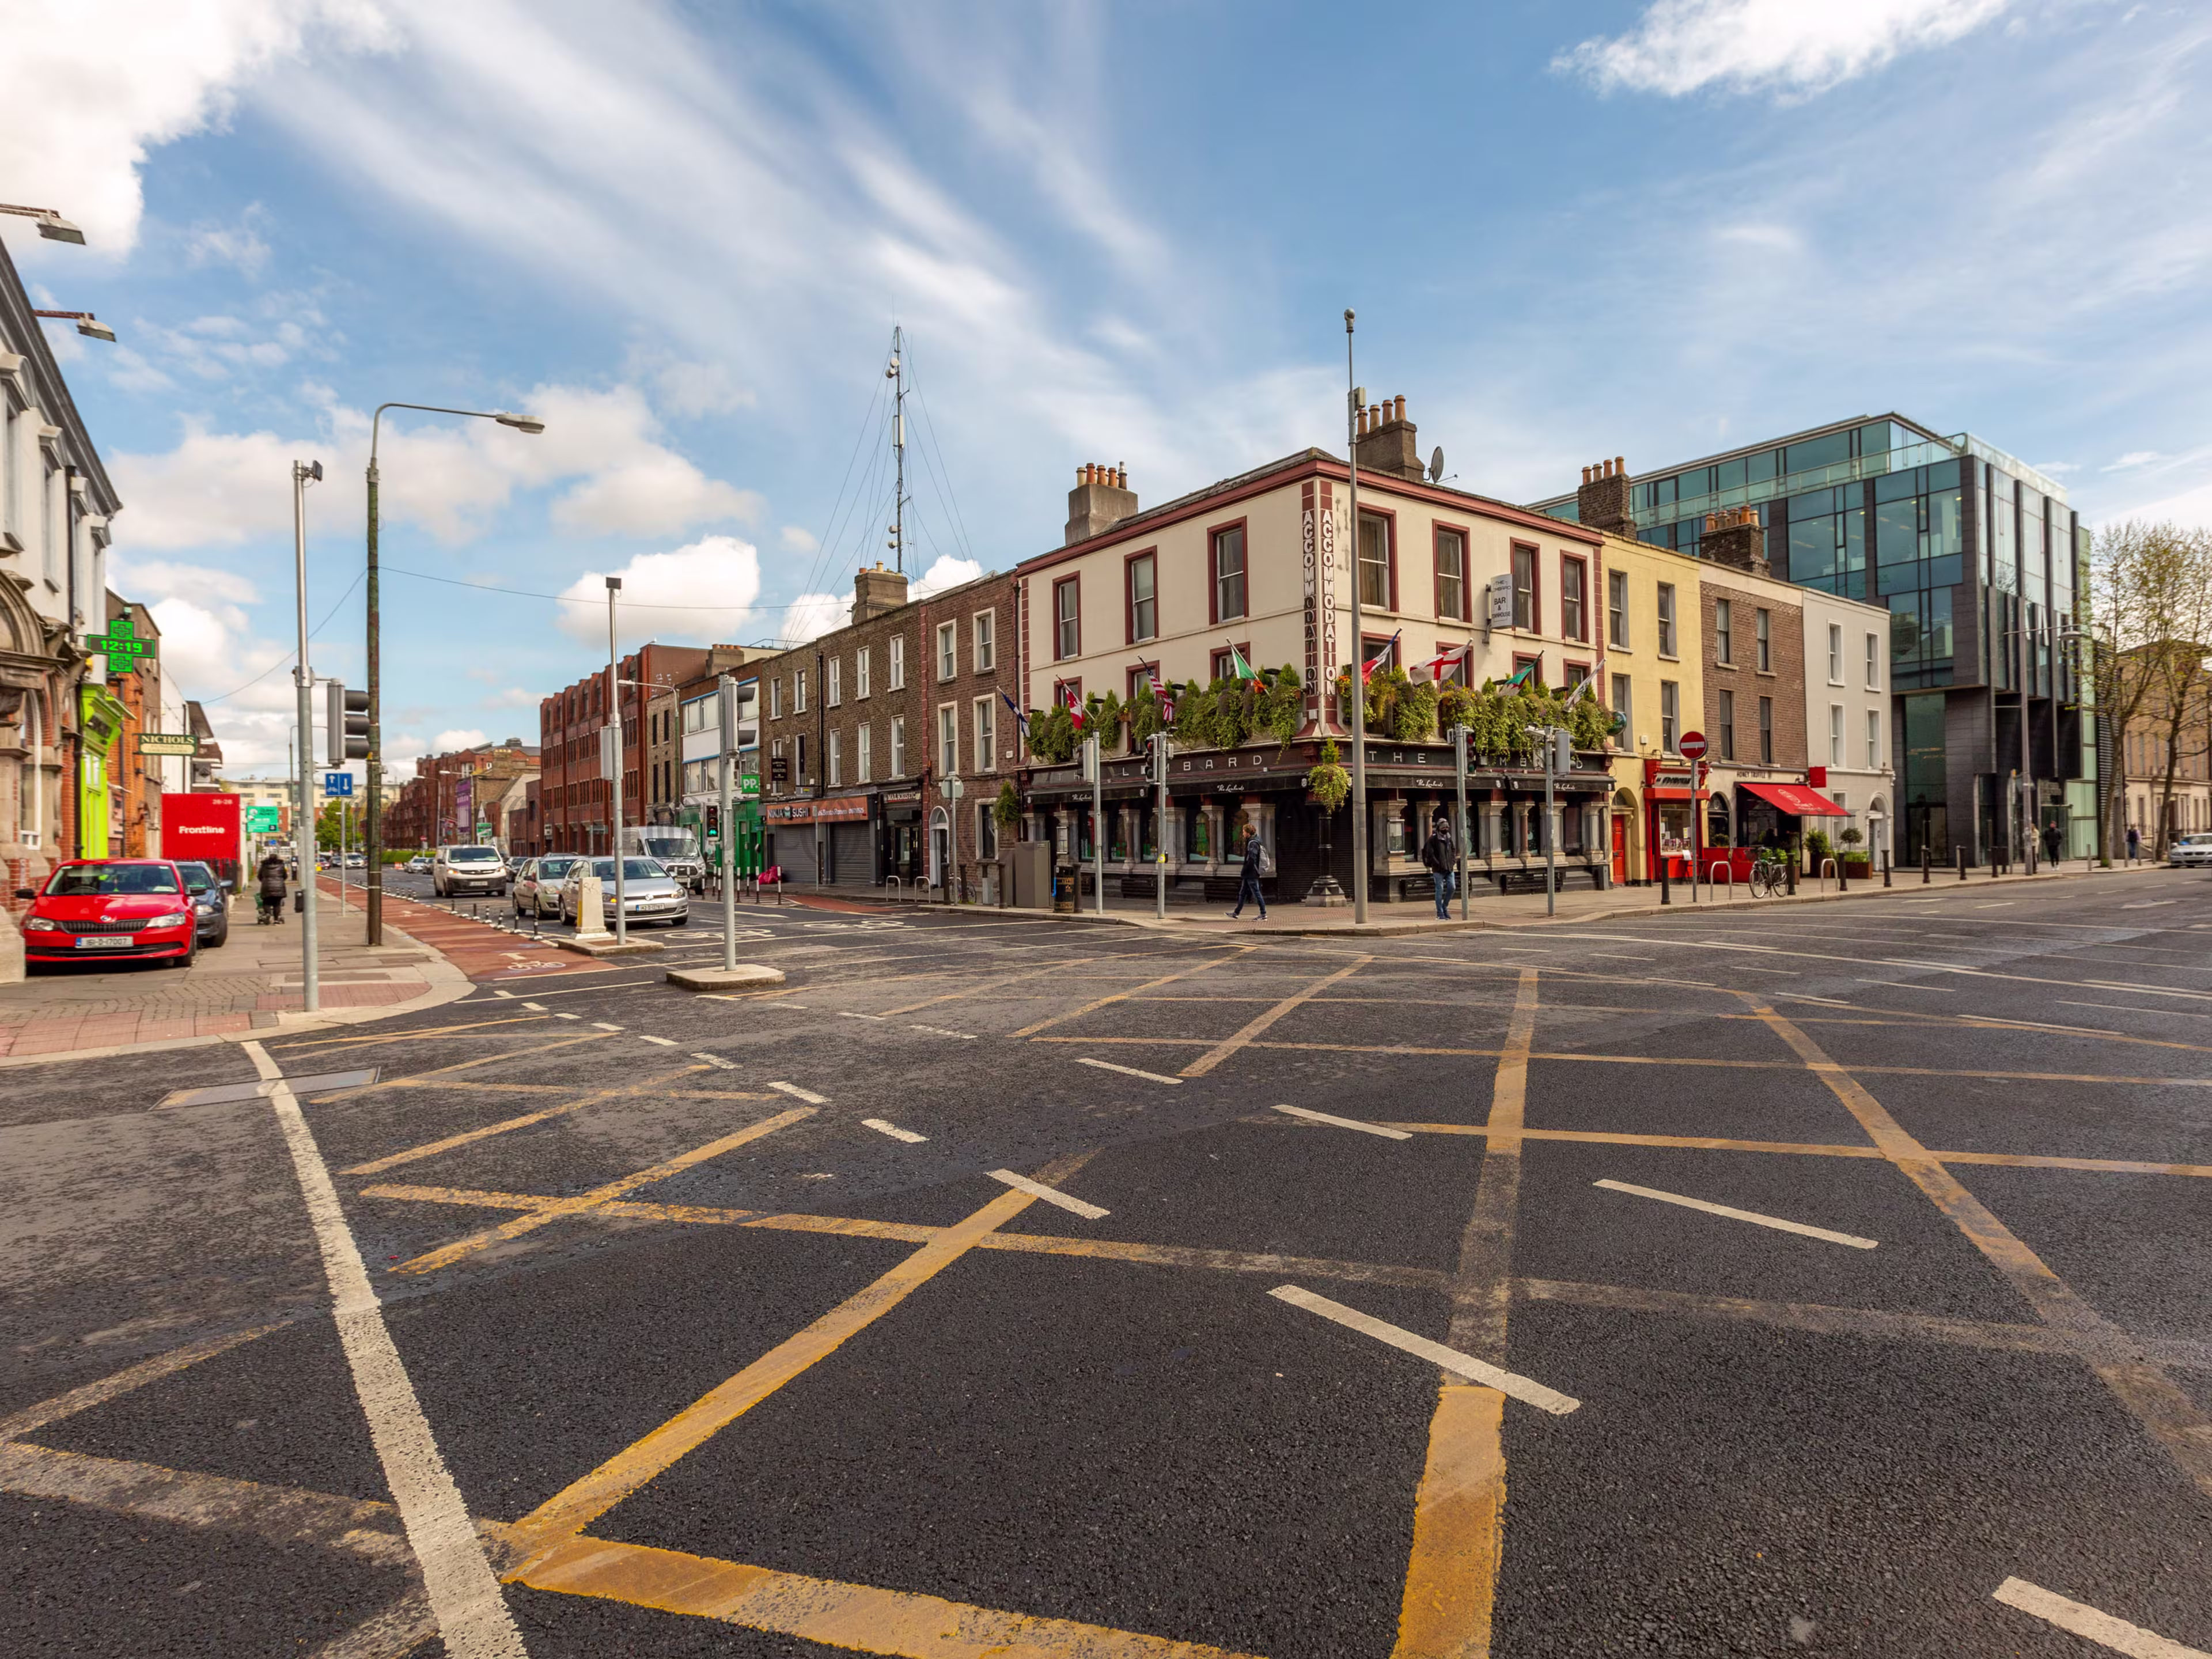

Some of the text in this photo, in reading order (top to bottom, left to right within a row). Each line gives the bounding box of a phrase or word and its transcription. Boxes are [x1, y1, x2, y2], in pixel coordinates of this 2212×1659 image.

[1303, 510, 1317, 695] ACCOMMODATION
[1322, 509, 1336, 695] ACCOMMODATION
[1494, 597, 1506, 605] BAR
[100, 640, 142, 653] 12:19
[141, 736, 194, 744] NICHOLS
[1369, 751, 1426, 763] THE
[792, 808, 809, 817] SUSHI
[179, 826, 225, 834] Frontline
